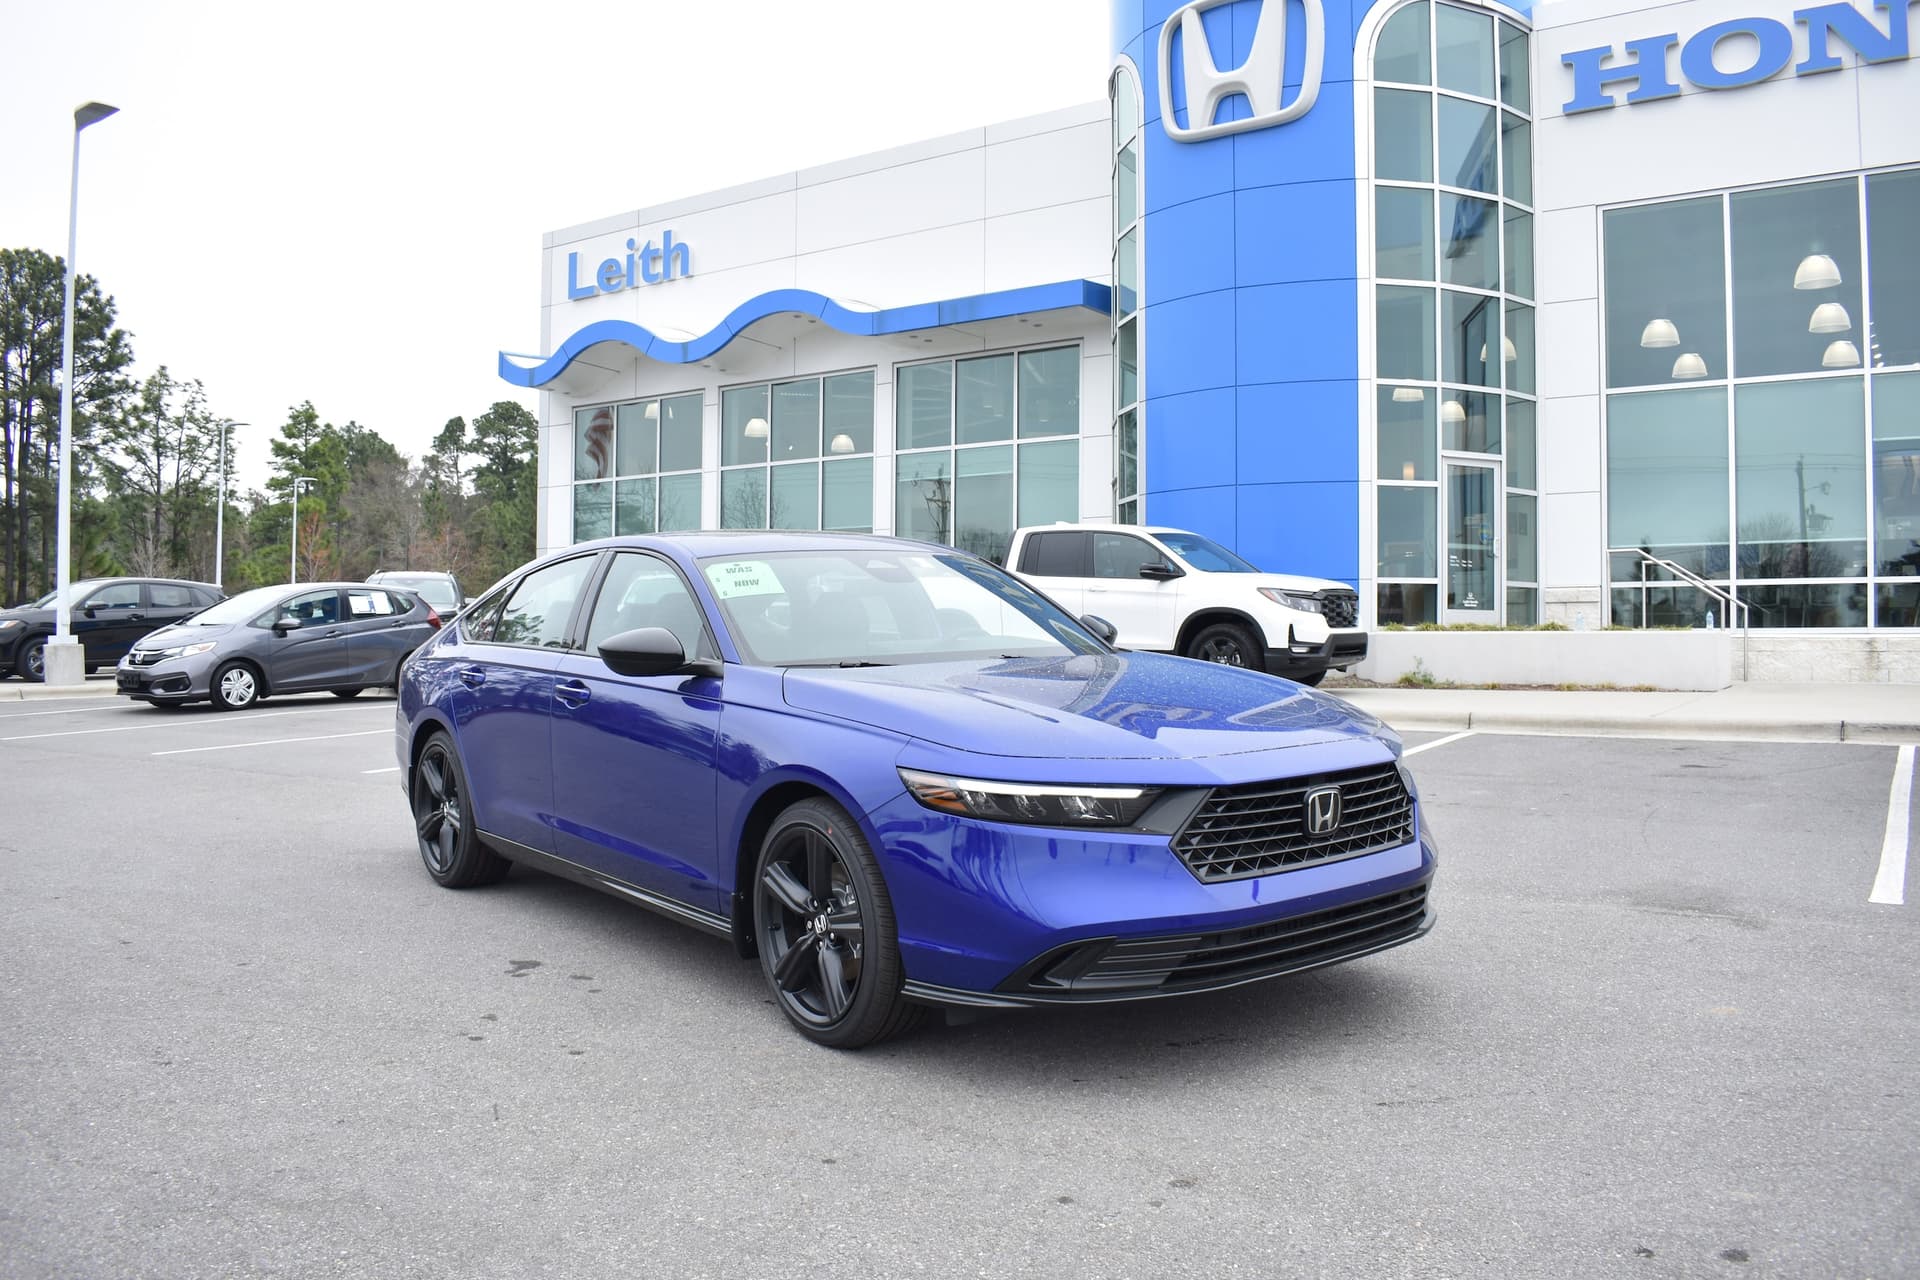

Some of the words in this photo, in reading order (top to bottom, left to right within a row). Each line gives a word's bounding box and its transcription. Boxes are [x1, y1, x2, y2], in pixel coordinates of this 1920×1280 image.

[1560, 0, 1920, 115] HON
[567, 229, 691, 301] Leith
[725, 566, 753, 574] WAS
[734, 579, 760, 588] NOW
